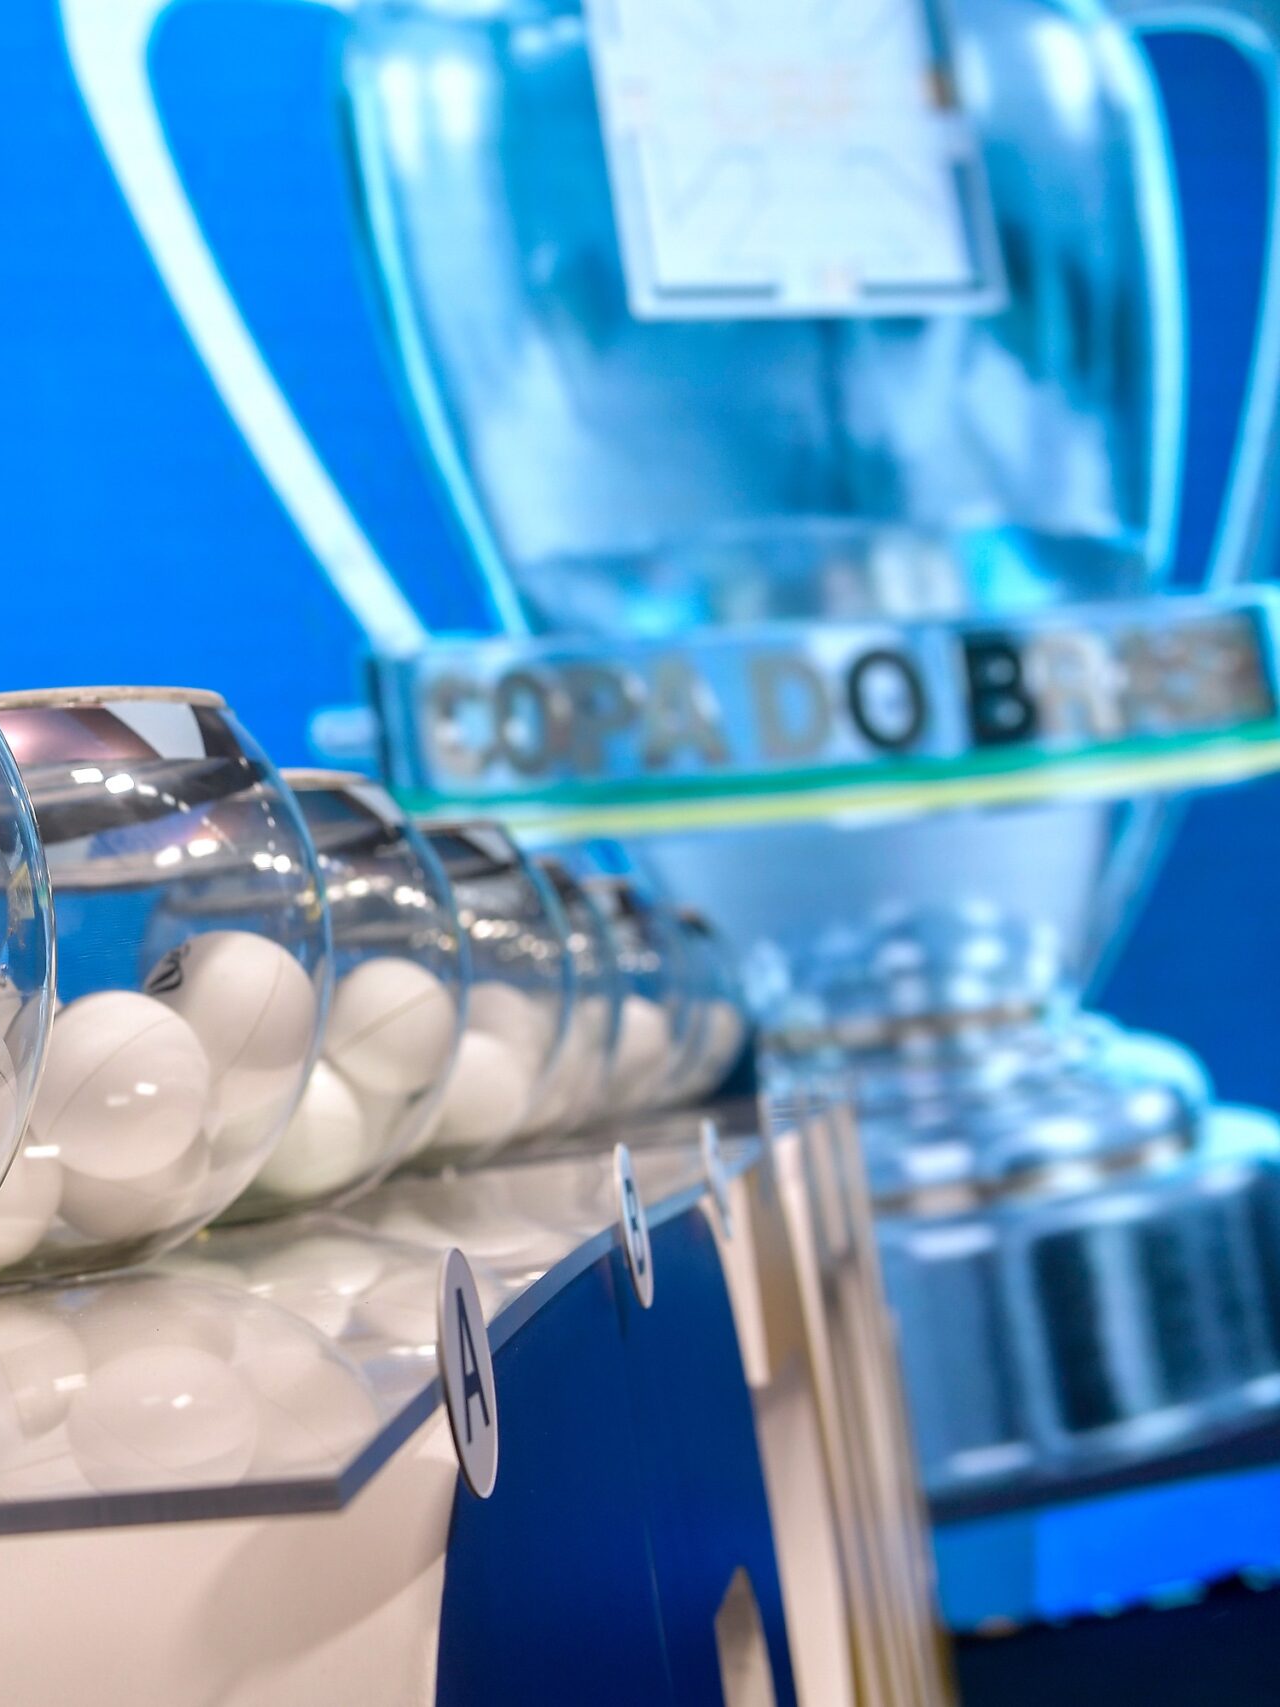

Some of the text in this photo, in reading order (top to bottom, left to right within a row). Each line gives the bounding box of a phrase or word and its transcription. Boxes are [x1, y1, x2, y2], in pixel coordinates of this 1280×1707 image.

[420, 652, 724, 779] COPA
[743, 642, 925, 766] DO
[456, 1287, 490, 1445] A
